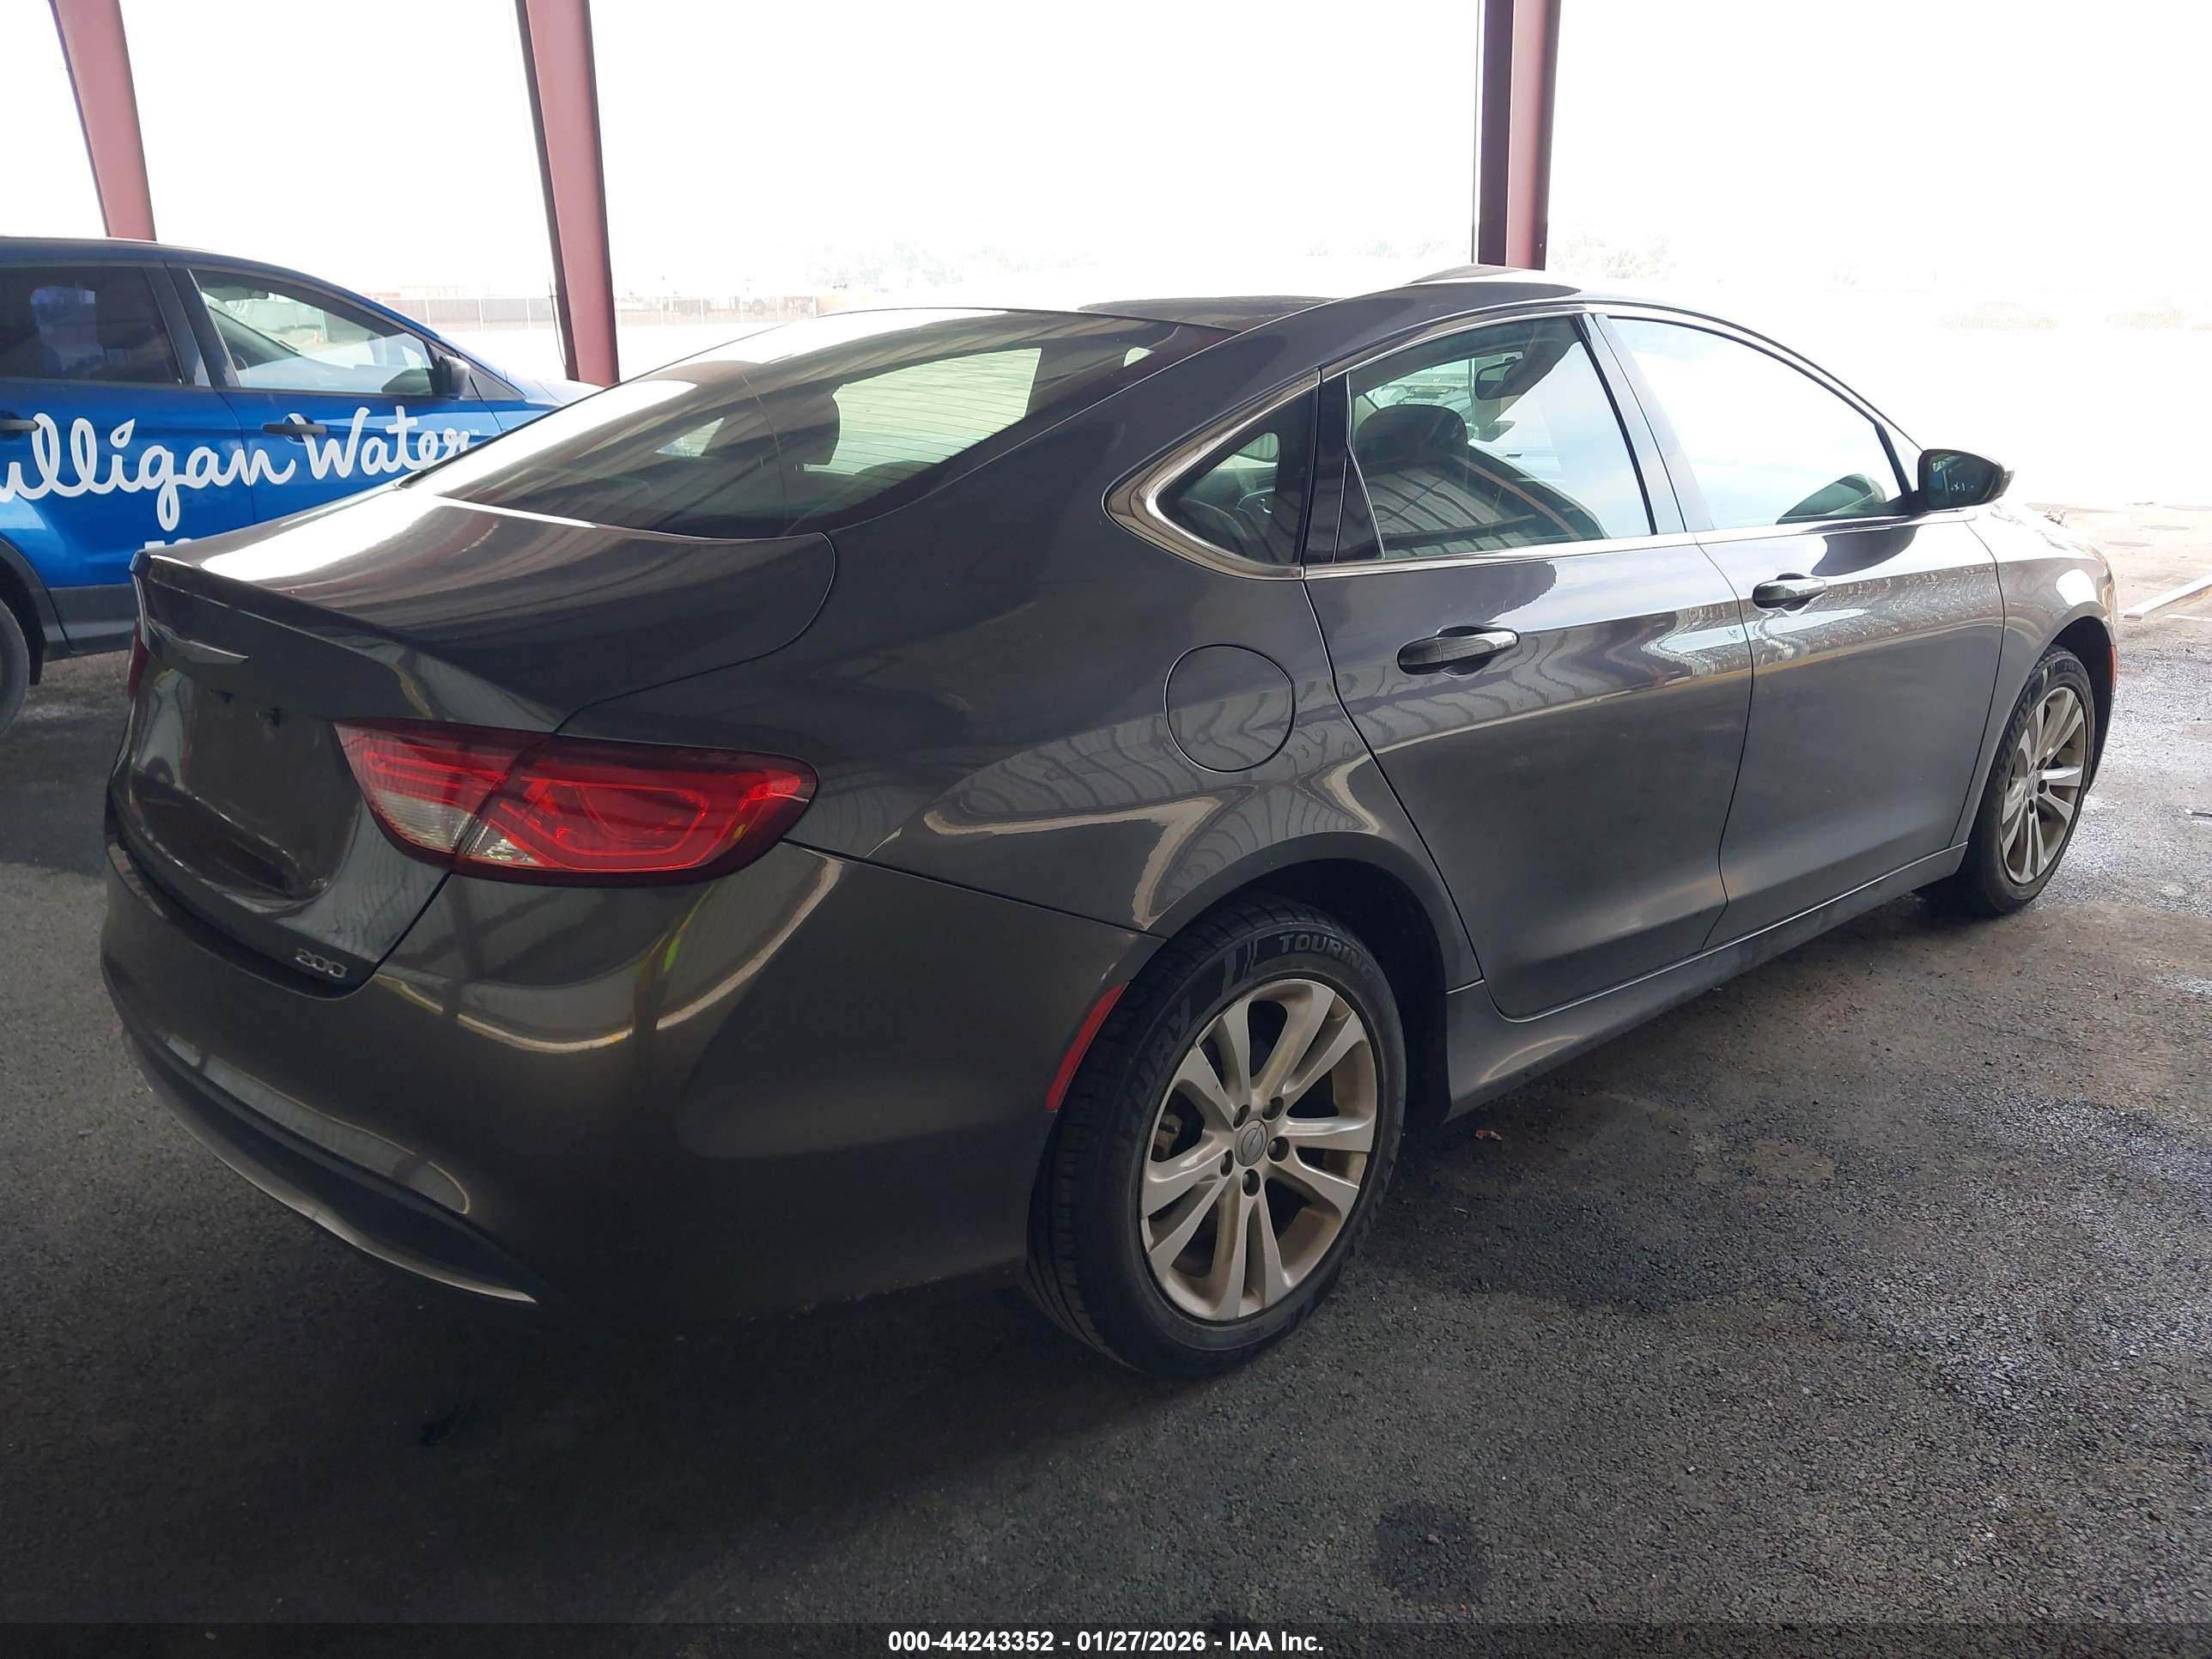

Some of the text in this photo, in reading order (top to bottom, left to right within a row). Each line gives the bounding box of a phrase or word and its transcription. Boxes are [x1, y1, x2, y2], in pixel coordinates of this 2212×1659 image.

[288, 404, 471, 481] Water
[295, 948, 348, 978] 200
[1278, 933, 1374, 980] TOURING
